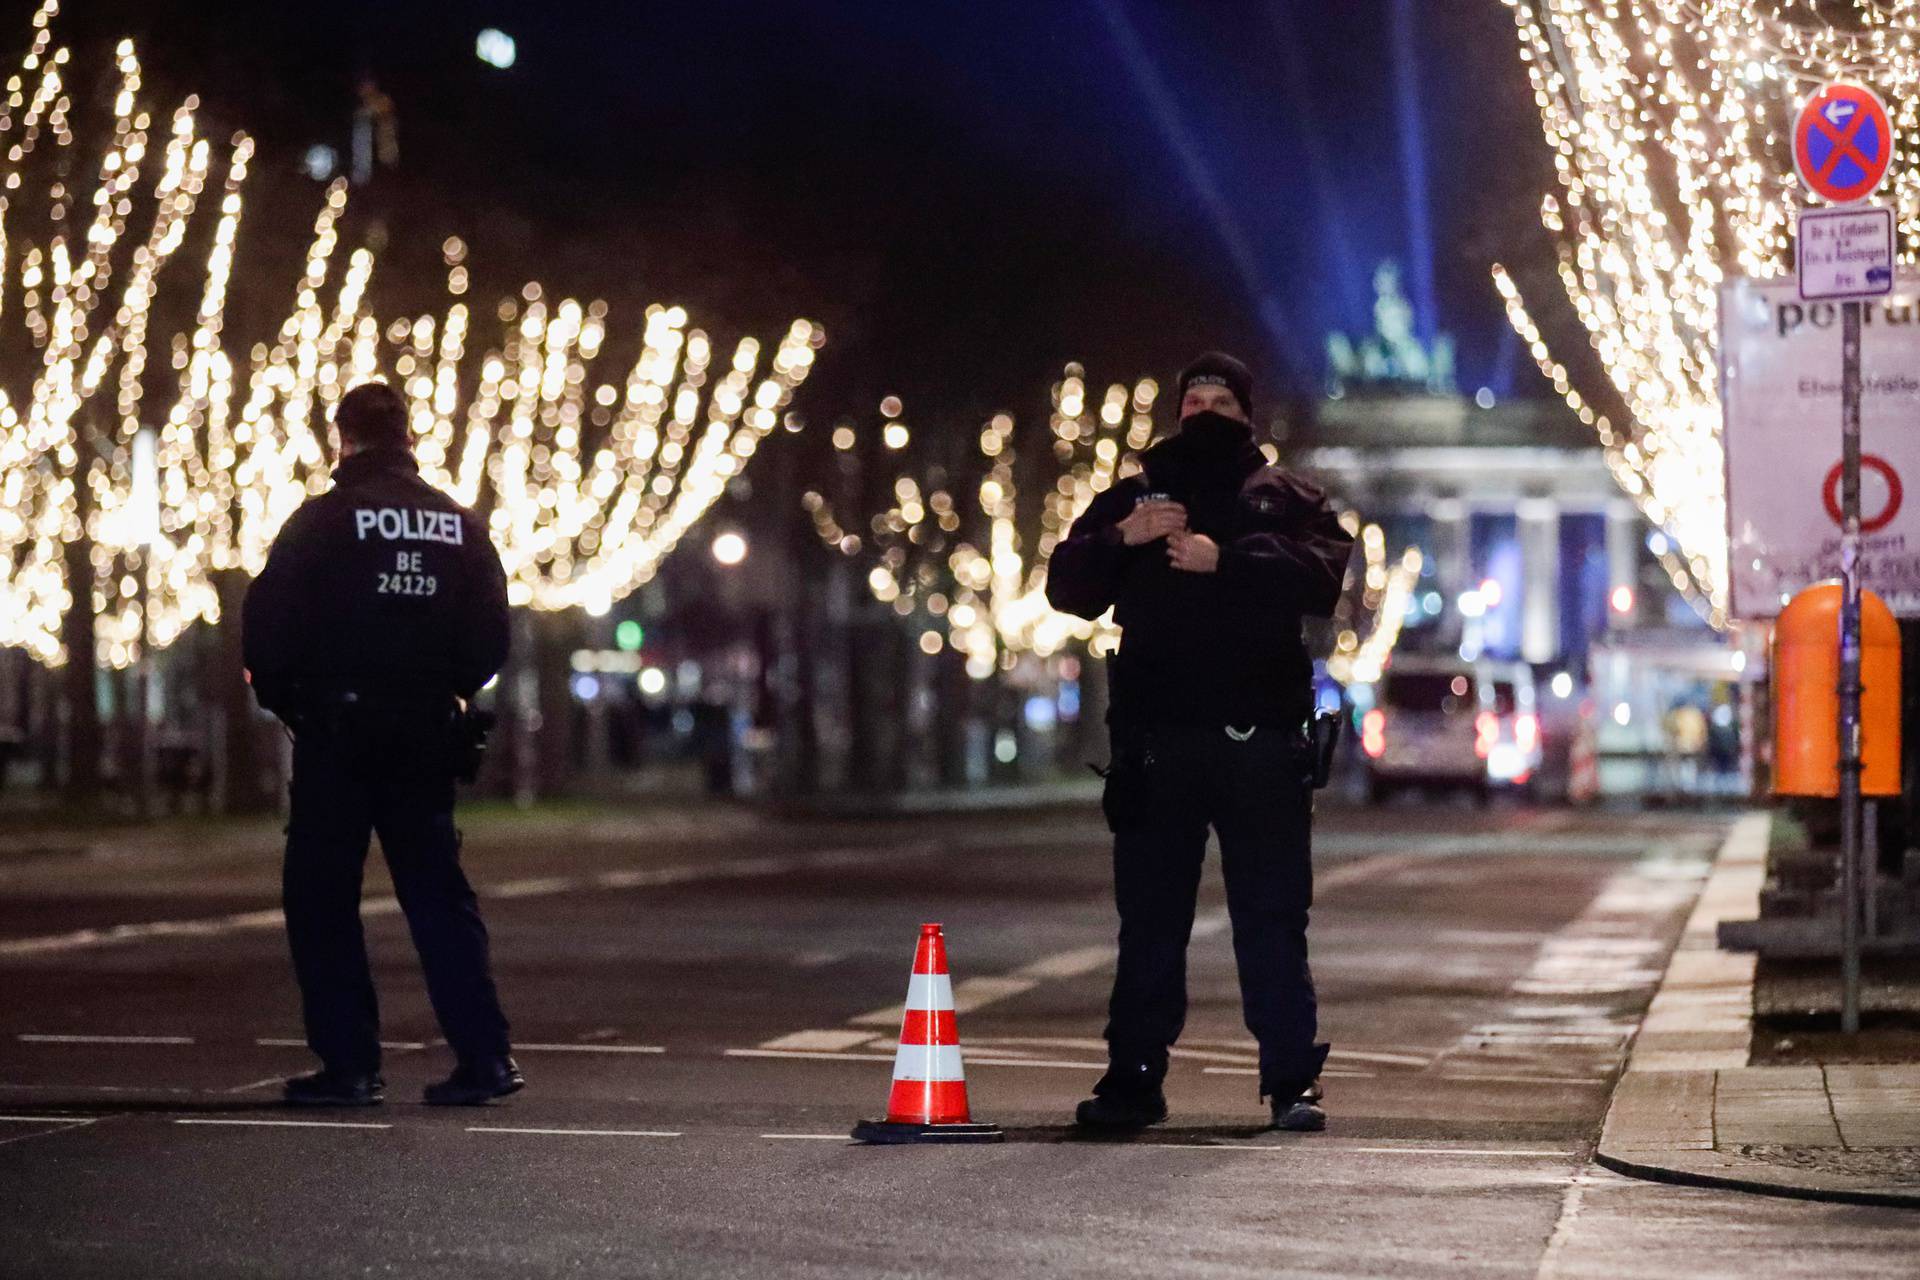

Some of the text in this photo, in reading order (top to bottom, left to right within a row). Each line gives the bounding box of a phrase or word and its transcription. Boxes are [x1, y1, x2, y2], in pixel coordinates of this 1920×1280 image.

[355, 507, 463, 545] POLIZEI
[396, 551, 422, 572] BE
[377, 573, 437, 596] 24129
